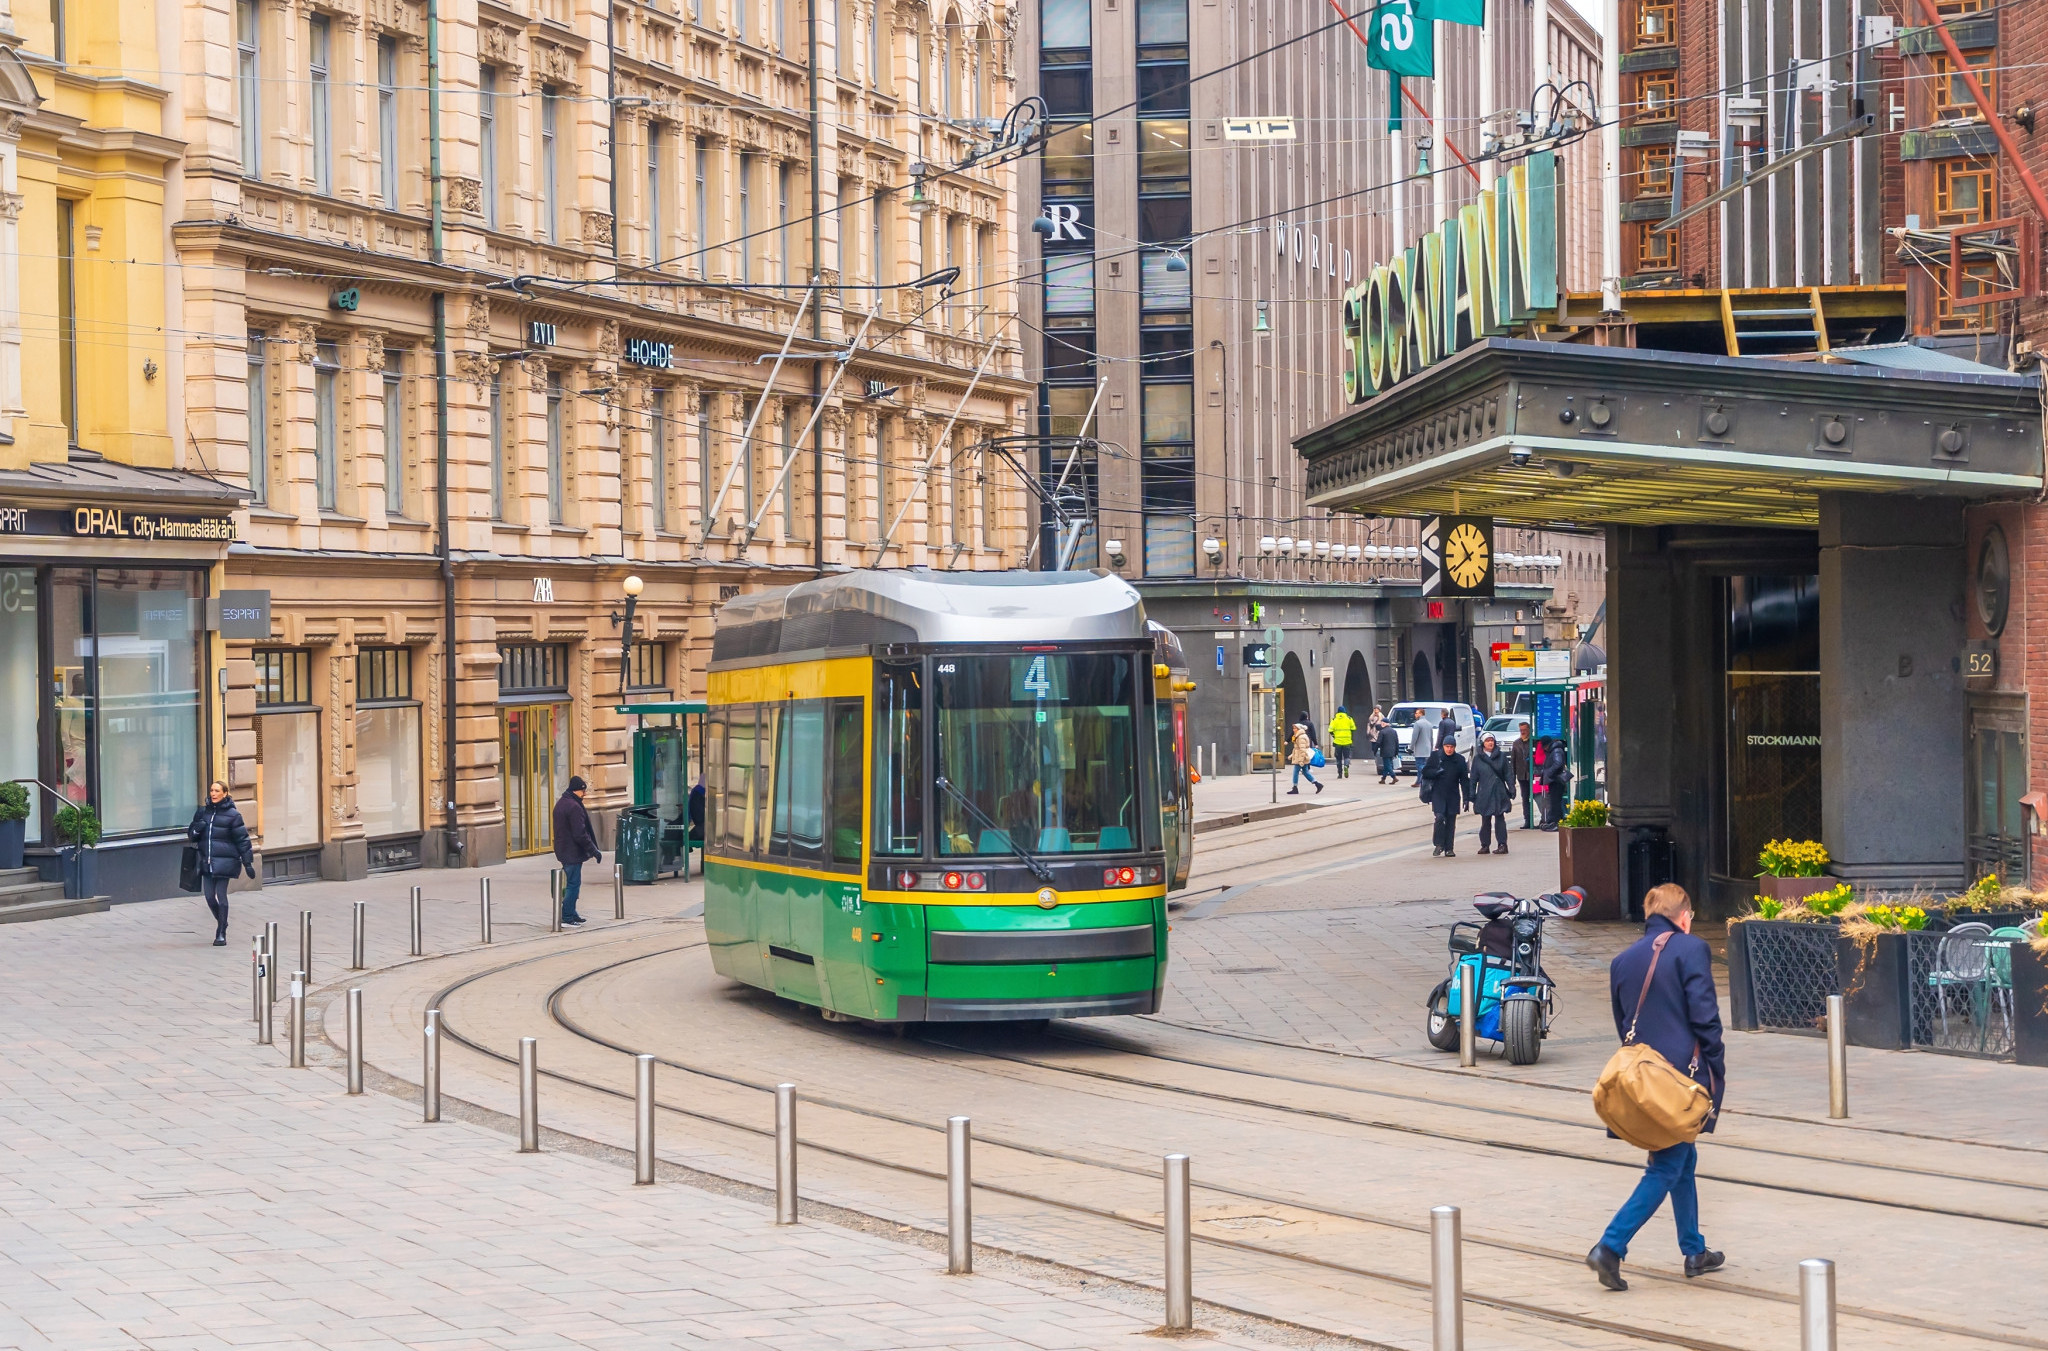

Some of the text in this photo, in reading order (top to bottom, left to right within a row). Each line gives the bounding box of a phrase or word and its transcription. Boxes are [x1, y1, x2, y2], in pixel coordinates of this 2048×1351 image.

[1277, 219, 1352, 282] WORLD
[1343, 150, 1558, 404] STOCKMANN
[534, 321, 557, 346] EVLI
[631, 337, 675, 369] HOHDE
[0, 507, 28, 532] PRIT
[75, 507, 239, 541] ORAL City-Hammaslääkärit
[533, 577, 554, 602] ZARA
[223, 608, 261, 620] ESPRIT
[937, 664, 956, 673] 448
[1969, 653, 1991, 672] 52
[1024, 655, 1050, 698] 4
[1746, 735, 1822, 745] STOCKMANN
